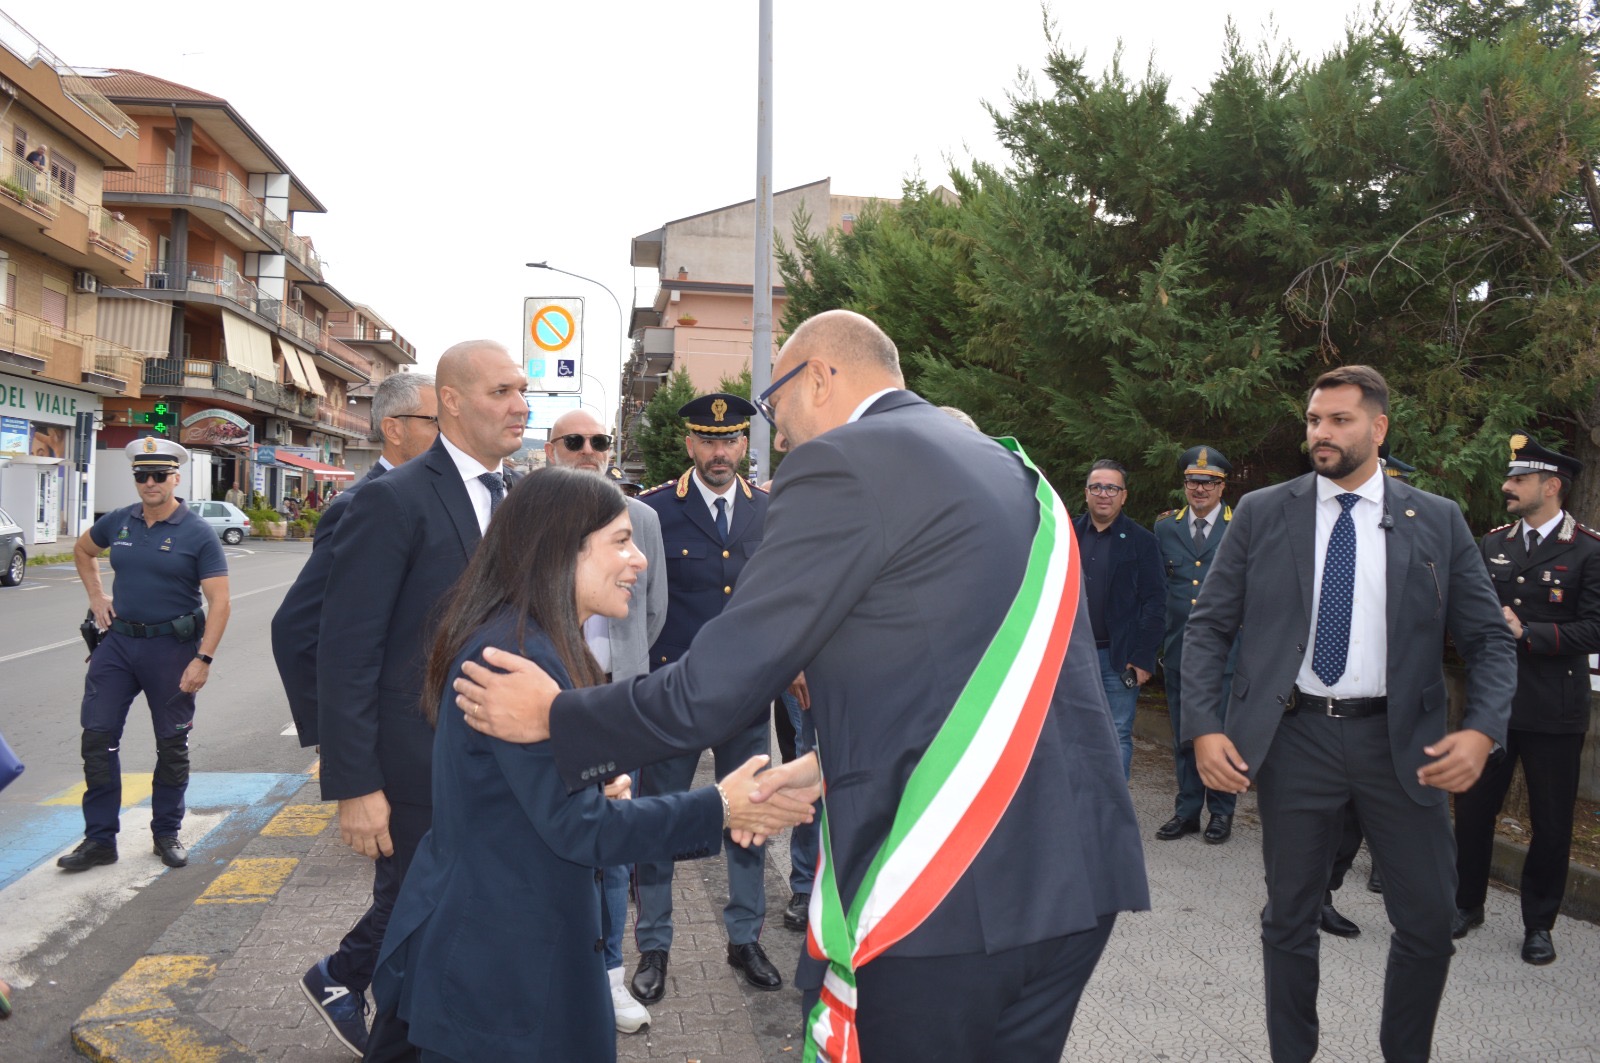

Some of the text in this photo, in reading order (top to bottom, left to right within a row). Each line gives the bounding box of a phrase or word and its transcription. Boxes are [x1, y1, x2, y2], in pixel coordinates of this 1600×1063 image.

[0, 383, 77, 417] DEL VIALE
[321, 986, 350, 1007] A
